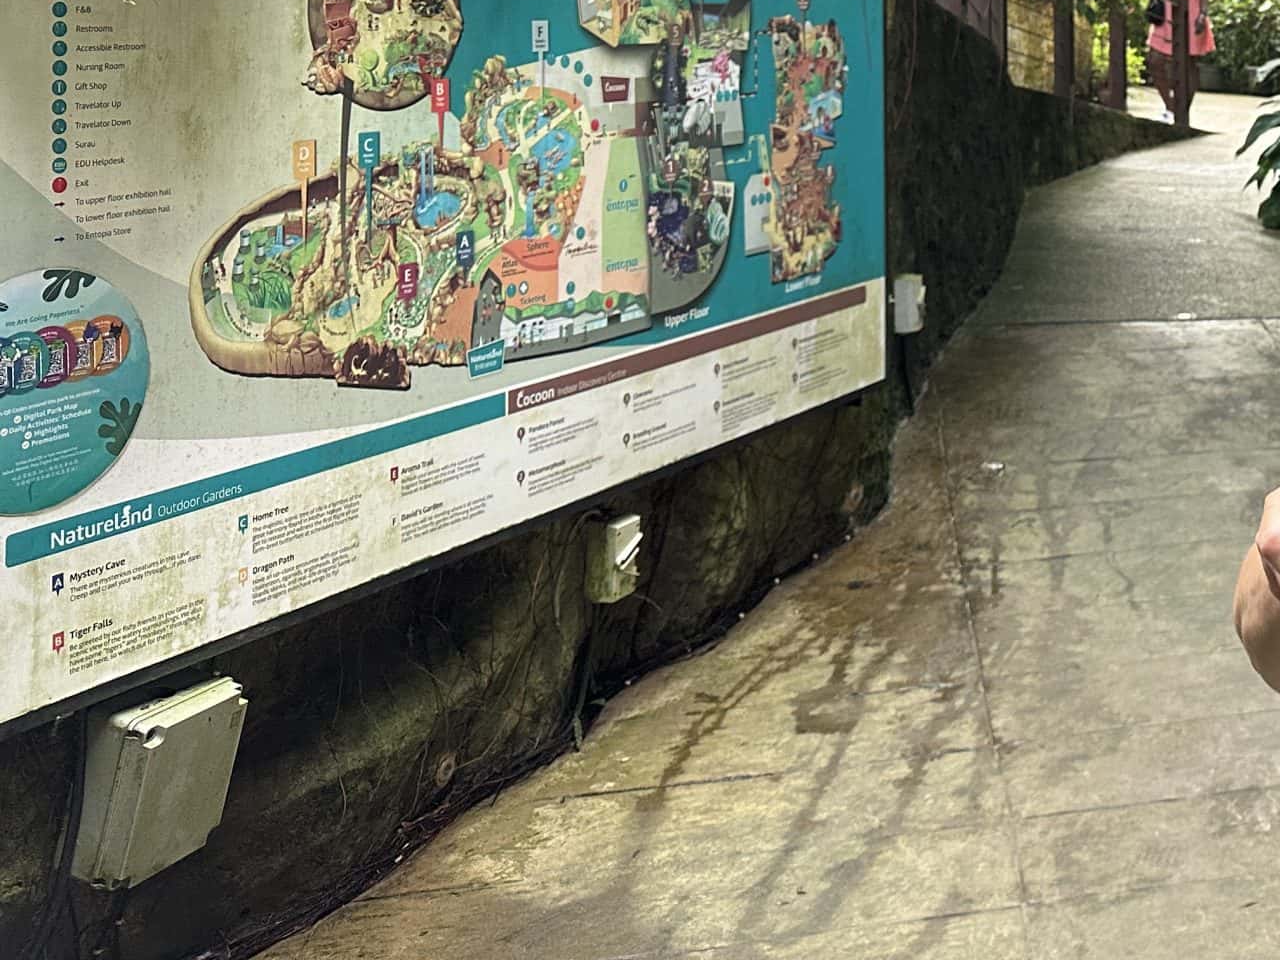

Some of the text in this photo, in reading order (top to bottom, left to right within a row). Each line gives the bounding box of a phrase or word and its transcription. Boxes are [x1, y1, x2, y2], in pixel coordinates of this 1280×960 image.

[76, 44, 112, 52] Accessible
[76, 64, 104, 72] Nursing
[89, 82, 107, 91] Shop
[436, 83, 444, 96] B
[75, 121, 110, 129] Travelator
[364, 138, 373, 152] C
[299, 146, 310, 161] D
[75, 157, 125, 168] EDU Helpdesk
[85, 197, 105, 205] upper
[108, 194, 124, 202] floor
[125, 190, 157, 200] exhibition
[85, 214, 104, 222] lower
[106, 211, 123, 219] floor
[124, 208, 157, 217] exhibition
[85, 230, 111, 239] Entopia
[460, 235, 469, 248] A
[404, 269, 411, 282] E
[665, 310, 688, 328] Upper
[516, 388, 555, 408] Cocoon
[9, 426, 26, 434] Daily
[62, 409, 92, 420] Schedule
[23, 411, 45, 420] Digital
[34, 424, 68, 437] Highlights
[50, 484, 242, 549] Natureland Outdoor Gardens
[253, 506, 289, 522] Home Tree
[69, 559, 126, 582] Mystery Cave
[253, 554, 294, 574] Dragon Path
[54, 577, 63, 589] A
[70, 585, 87, 593] There
[70, 592, 87, 602] Creep
[89, 587, 100, 596] and
[118, 578, 131, 588] your
[70, 618, 113, 639] Tiger Falls
